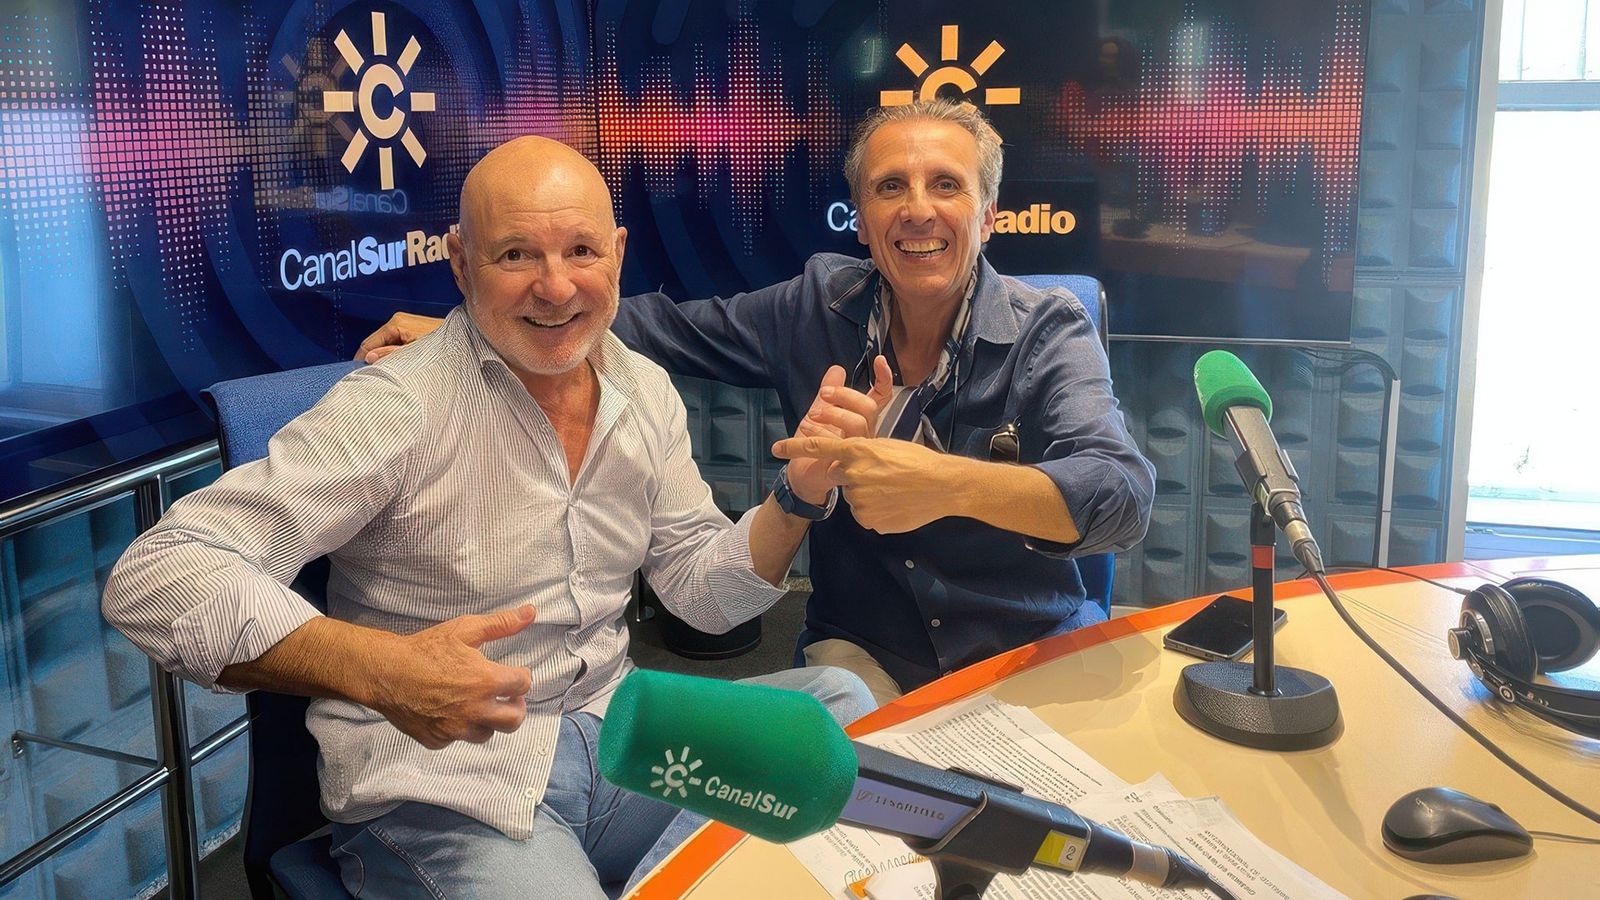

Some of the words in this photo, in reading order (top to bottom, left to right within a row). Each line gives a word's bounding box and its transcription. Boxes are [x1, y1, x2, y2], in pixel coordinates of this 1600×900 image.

[993, 203, 1077, 235] adio
[704, 775, 799, 821] CanalSur
[1065, 844, 1077, 861] 2
